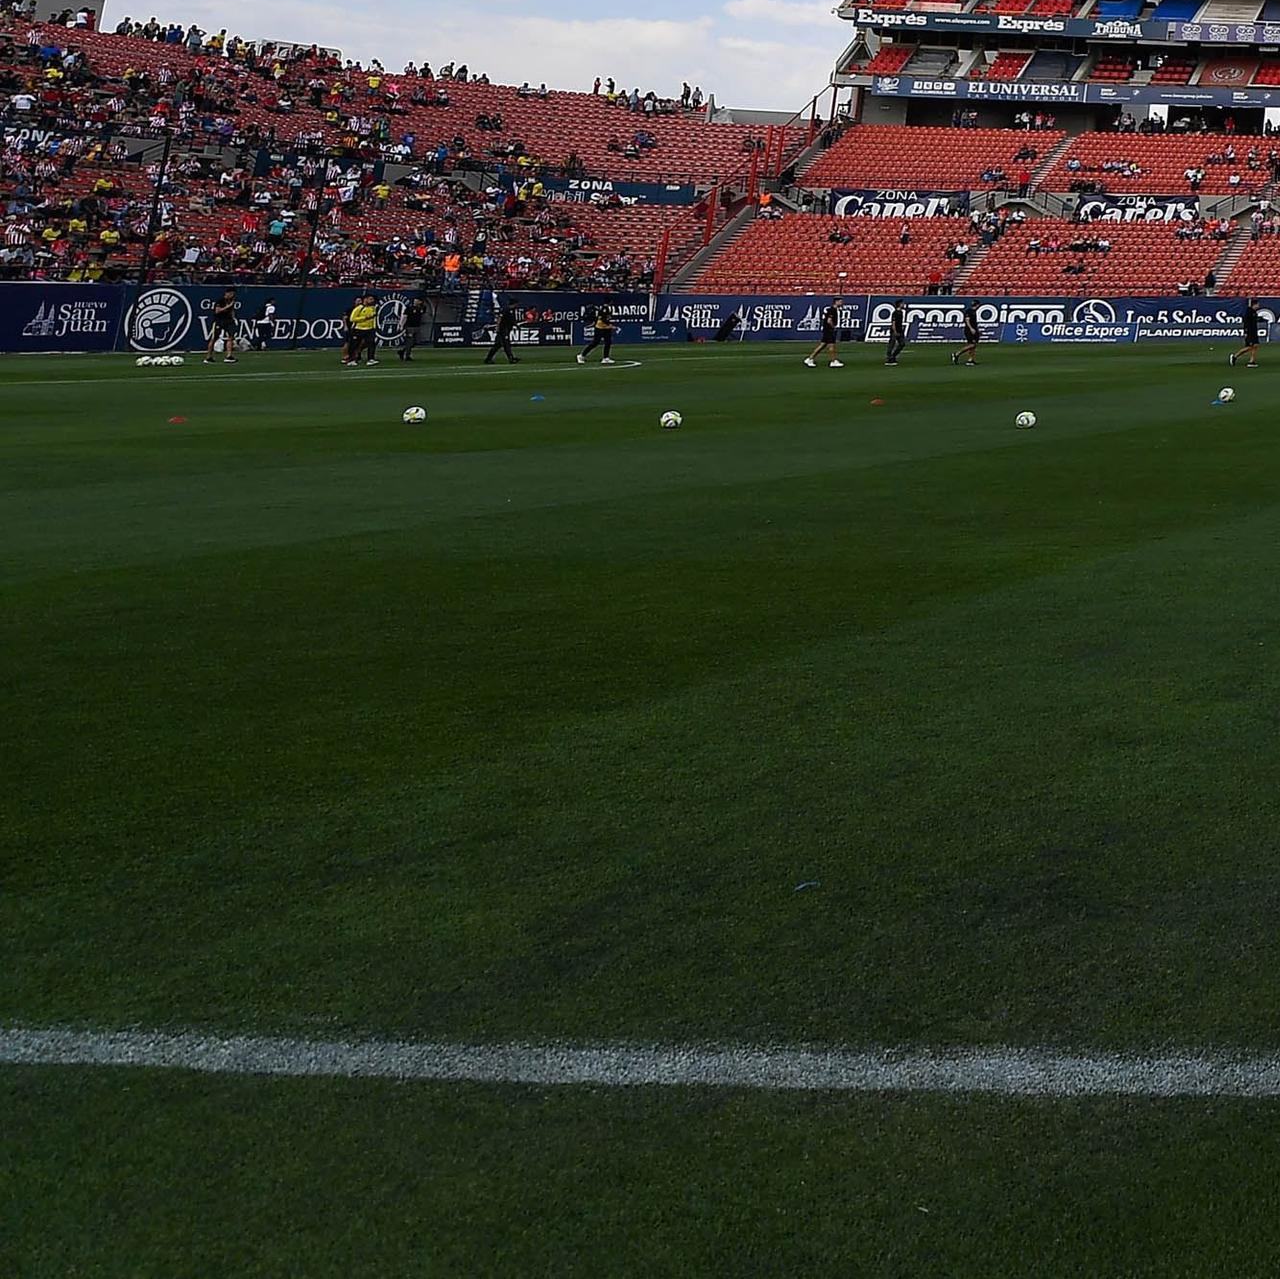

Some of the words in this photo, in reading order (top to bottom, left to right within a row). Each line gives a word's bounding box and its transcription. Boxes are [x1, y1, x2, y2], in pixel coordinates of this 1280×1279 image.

[857, 9, 927, 27] Exprés
[997, 15, 1065, 33] Exprés
[1093, 22, 1142, 34] TRIBUNA
[968, 82, 988, 93] EL
[989, 82, 1080, 96] UNIVERSAL
[568, 179, 614, 191] ZONA
[876, 191, 918, 200] ZONA
[74, 301, 107, 309] nuevo
[58, 304, 96, 320] San
[681, 306, 712, 319] San
[753, 306, 783, 319] San
[56, 319, 109, 337] Juan
[199, 316, 344, 340] VNEDOR
[686, 318, 722, 330] Juan
[752, 318, 793, 331] Juan
[493, 326, 539, 341] YÑEZ
[1041, 325, 1083, 336] Office
[1085, 325, 1130, 338] Expres
[1138, 328, 1181, 337] PLANO
[1183, 328, 1267, 338] INFORMATO
